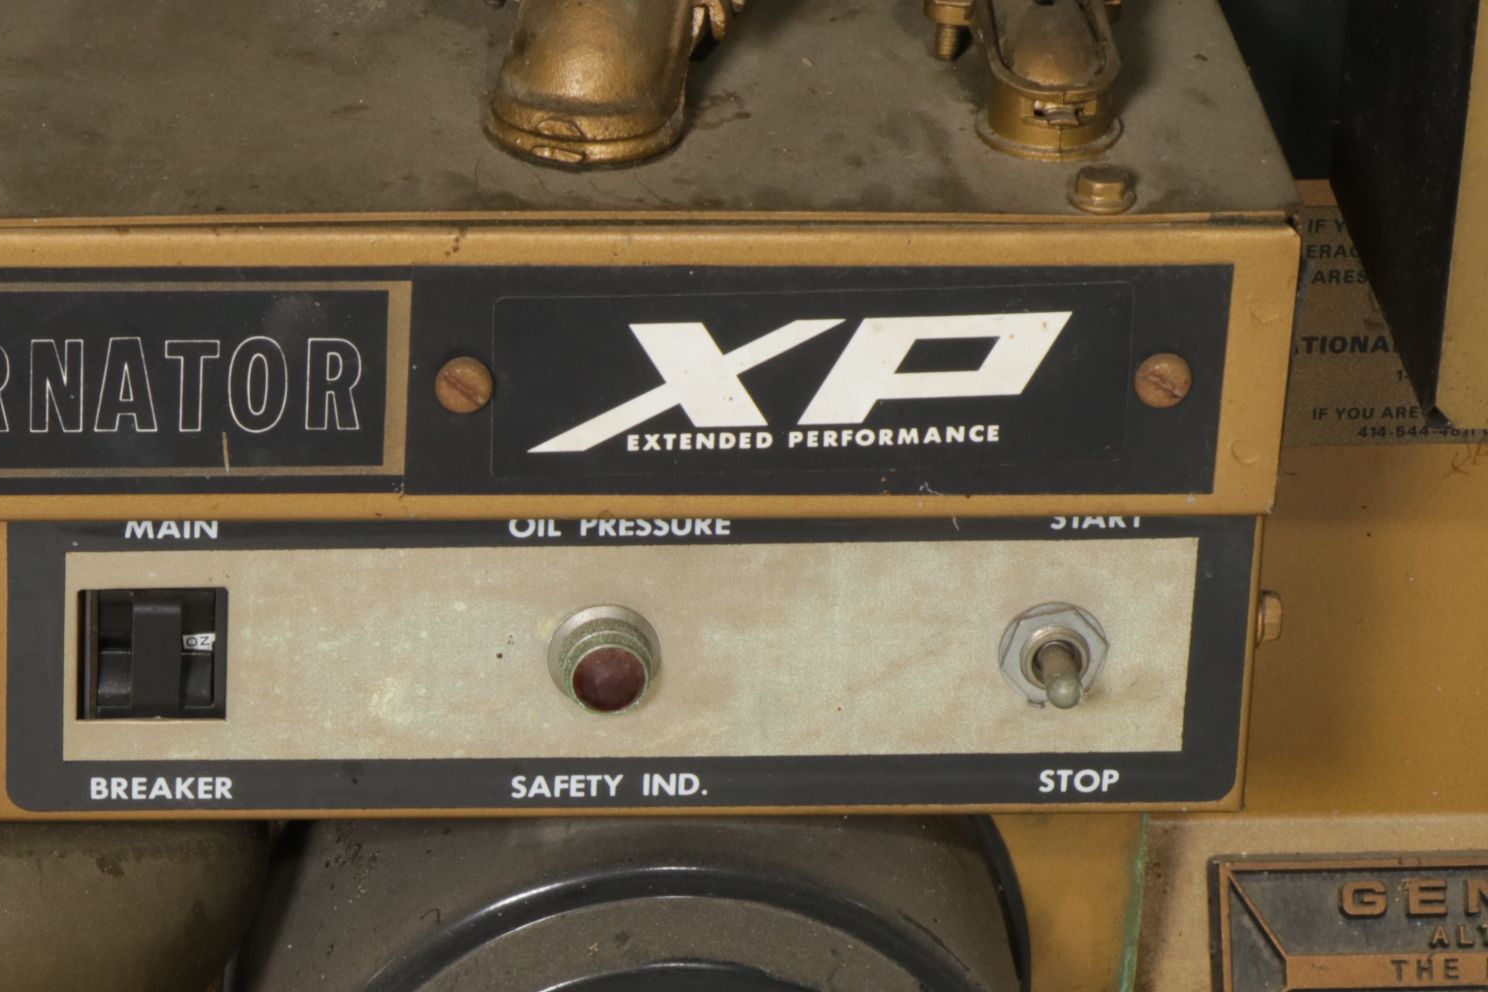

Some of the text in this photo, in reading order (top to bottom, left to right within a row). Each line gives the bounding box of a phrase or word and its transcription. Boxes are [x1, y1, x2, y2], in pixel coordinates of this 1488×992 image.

[1308, 218, 1327, 233] IF
[1295, 335, 1397, 354] TIONA
[527, 311, 1073, 453] XP
[1312, 405, 1419, 421] IF YOU ARE
[625, 424, 1001, 452] EXTENDED PERFORMANCE
[124, 520, 218, 540] MAIN
[508, 519, 731, 538] OIL PRESSURE
[90, 776, 233, 800] BREAKER
[511, 772, 709, 799] SAFETY IND.
[1038, 768, 1120, 793] STOP
[1390, 957, 1459, 981] THE
